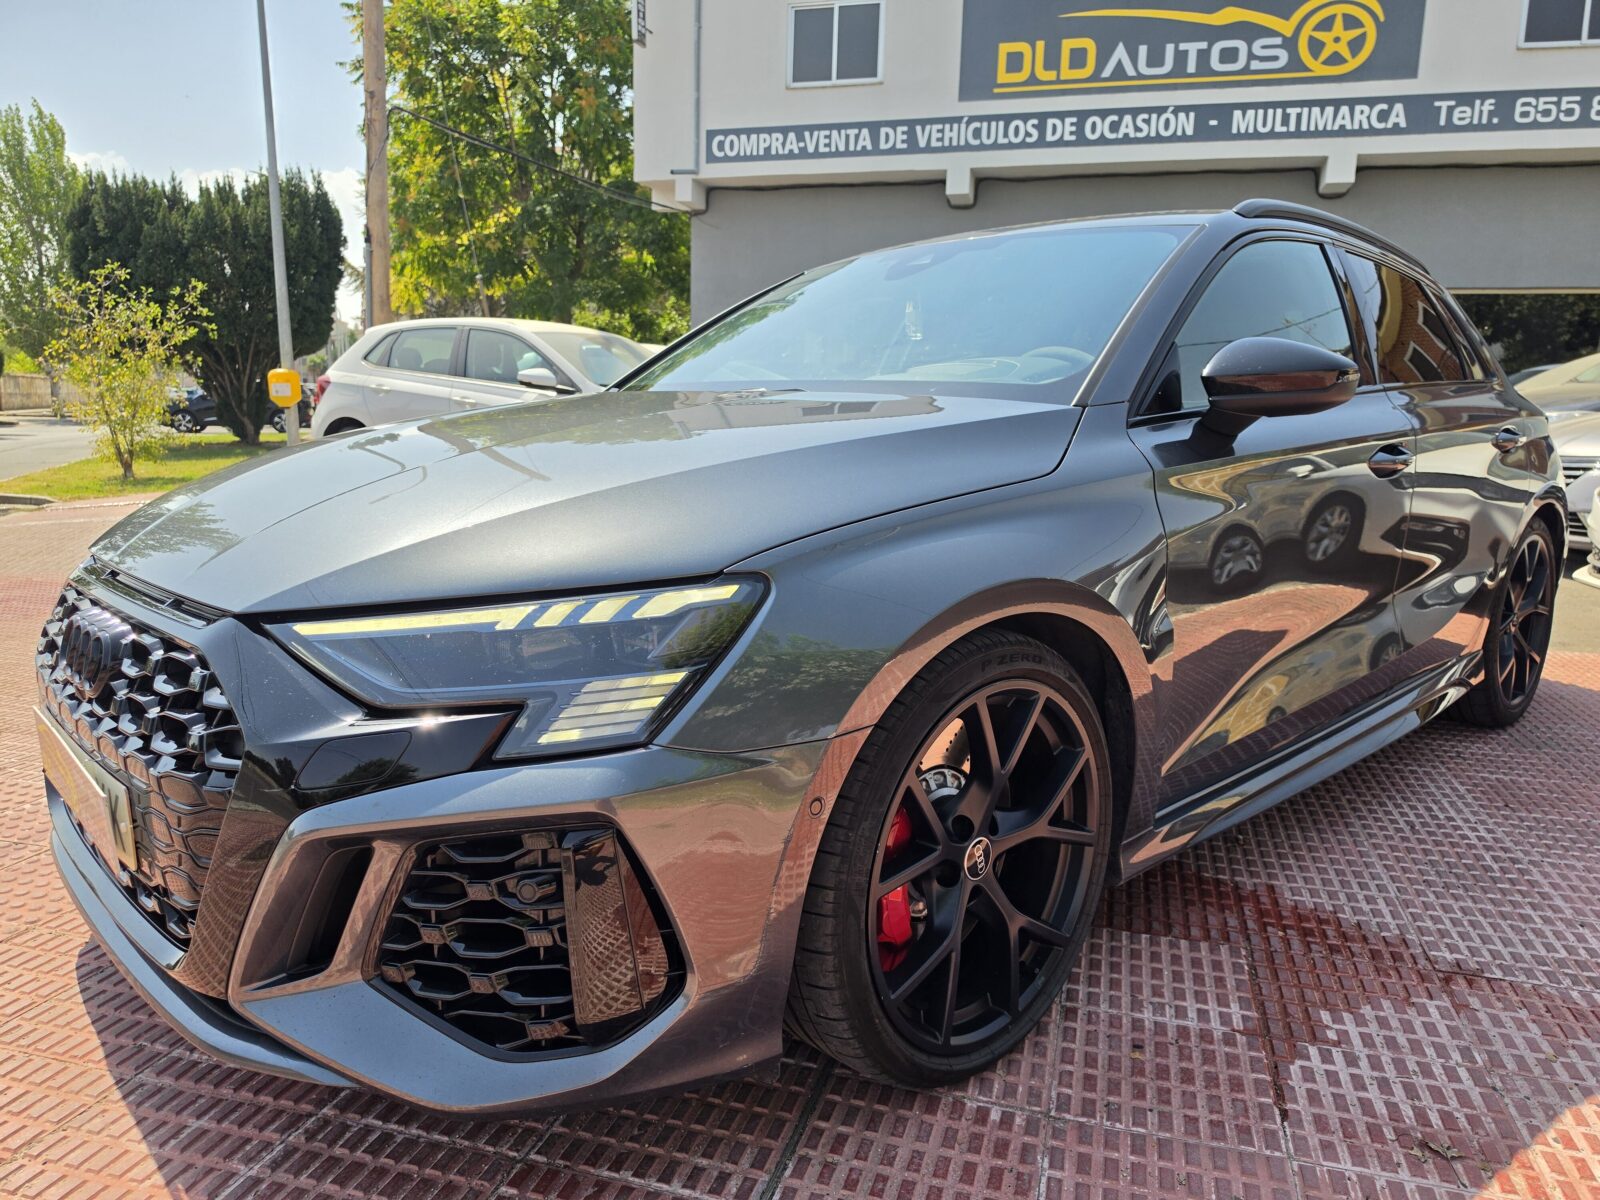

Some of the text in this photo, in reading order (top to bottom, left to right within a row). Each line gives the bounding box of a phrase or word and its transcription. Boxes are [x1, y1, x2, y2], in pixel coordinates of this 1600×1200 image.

[996, 36, 1289, 84] DLD AUTOS
[711, 127, 873, 158] COMPRA-VENTA
[879, 125, 909, 150] DE
[915, 116, 1039, 148] VEHÍCULOS
[1045, 116, 1078, 142] DE
[1084, 106, 1196, 141] OCASIÓN
[1231, 102, 1407, 134] MULTIMARCA
[1433, 98, 1499, 127] Telf.
[1513, 95, 1582, 124] 655
[996, 653, 1043, 666] ZERO
